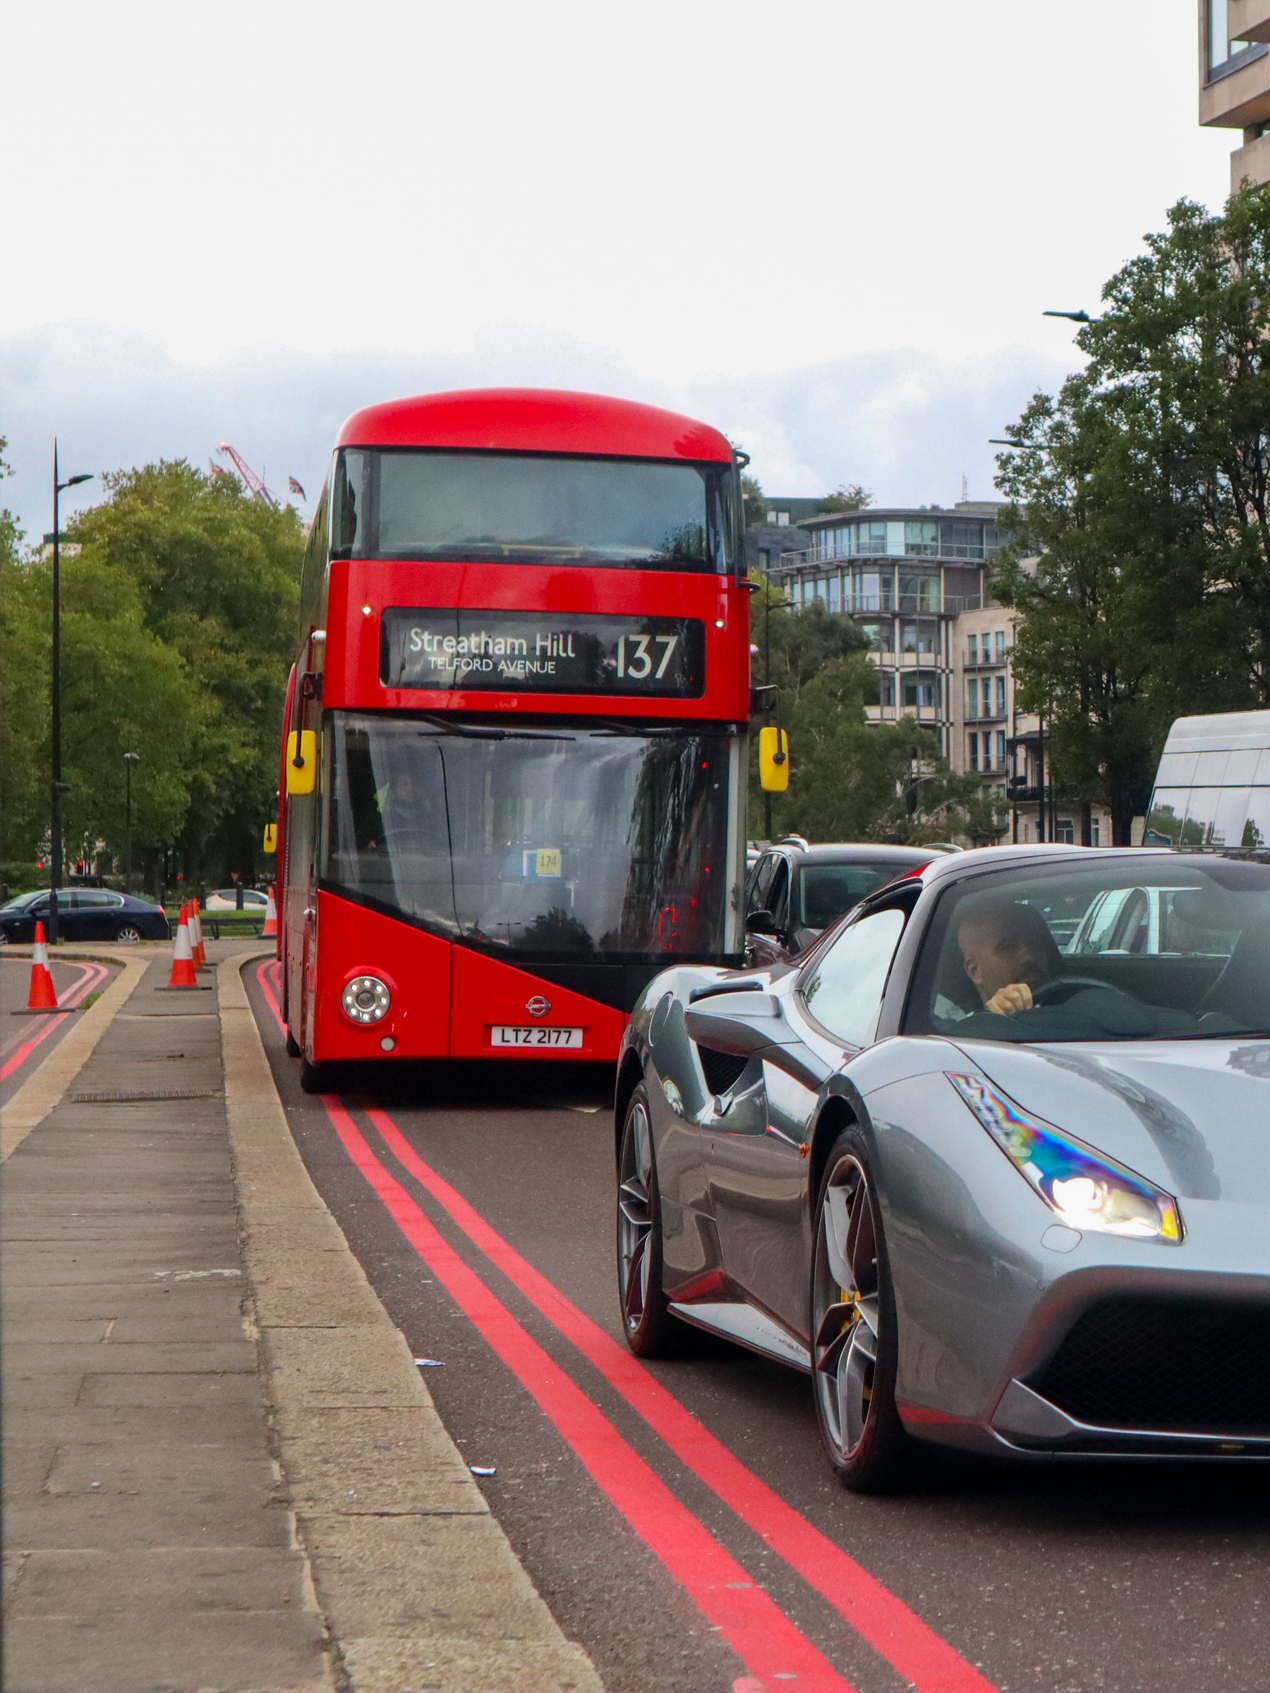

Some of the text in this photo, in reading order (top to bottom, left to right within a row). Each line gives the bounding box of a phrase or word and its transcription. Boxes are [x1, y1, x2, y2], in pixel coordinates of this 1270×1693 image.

[409, 628, 576, 657] Streatham Hill
[428, 657, 557, 673] TELFORD AVENUE
[617, 635, 678, 679] 137
[540, 855, 557, 867] 174
[501, 1028, 573, 1045] LTZ 2177
